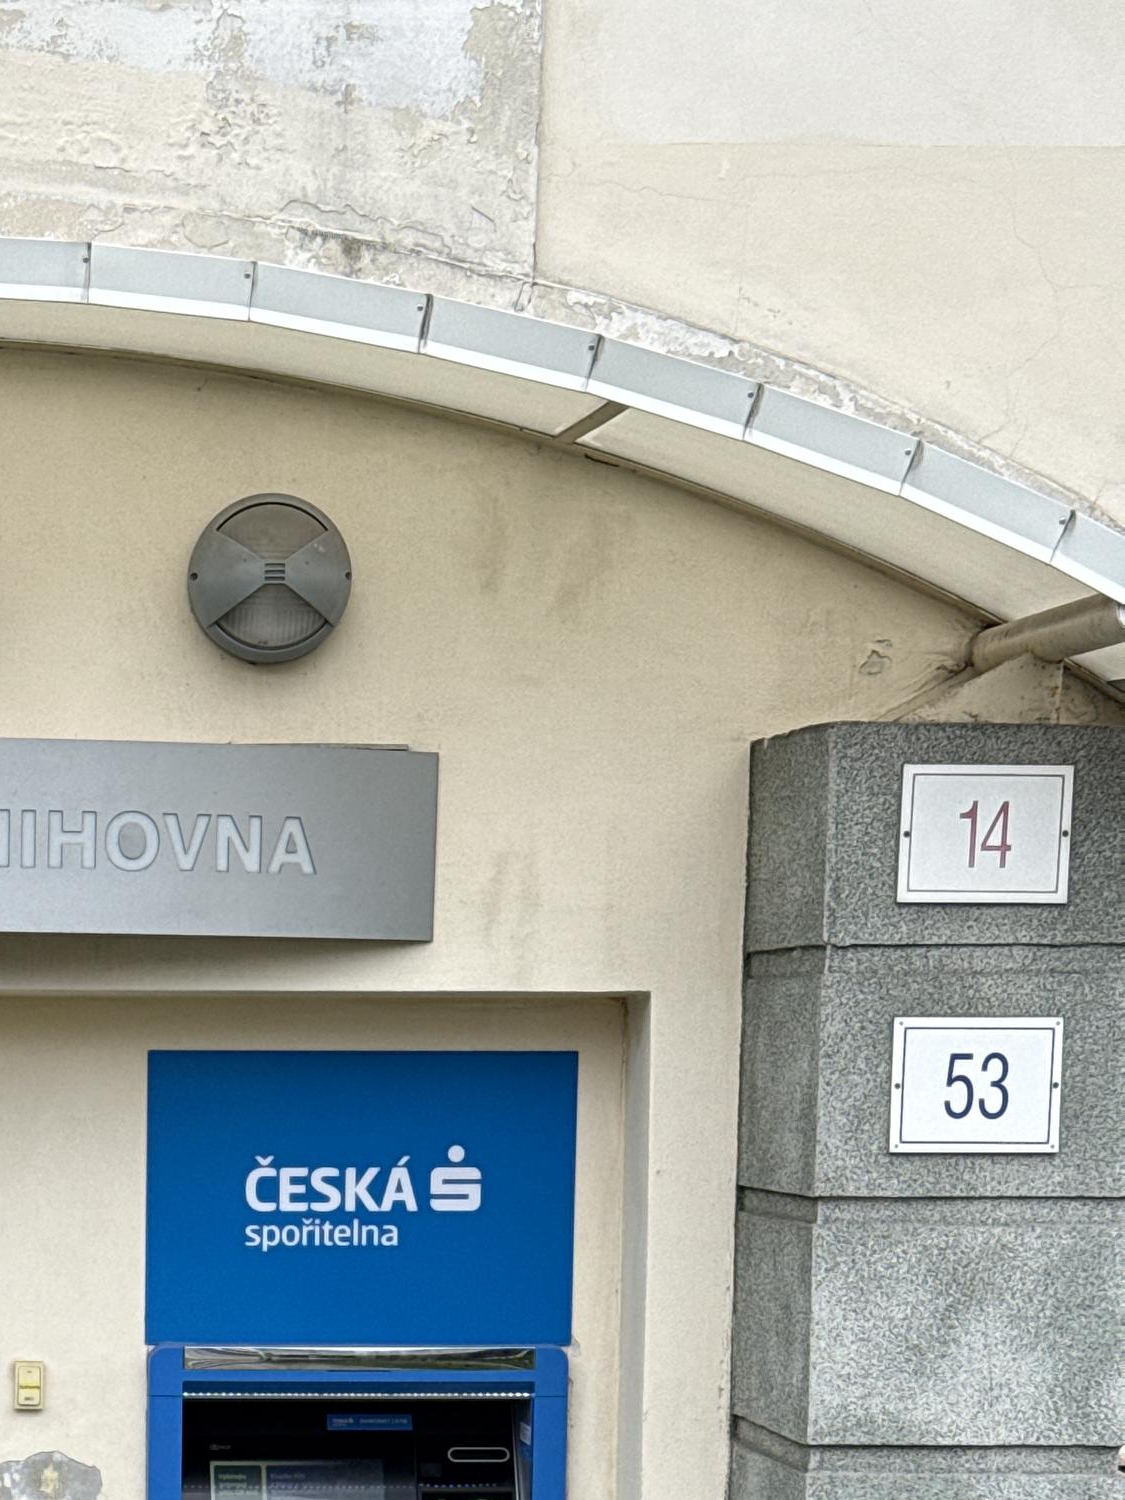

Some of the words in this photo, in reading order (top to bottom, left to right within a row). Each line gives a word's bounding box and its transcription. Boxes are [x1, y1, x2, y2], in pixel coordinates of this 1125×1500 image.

[959, 799, 1012, 869] 14
[943, 1051, 1010, 1120] 53
[244, 1154, 419, 1213] ČESKÁ
[244, 1217, 399, 1252] spořitelna
